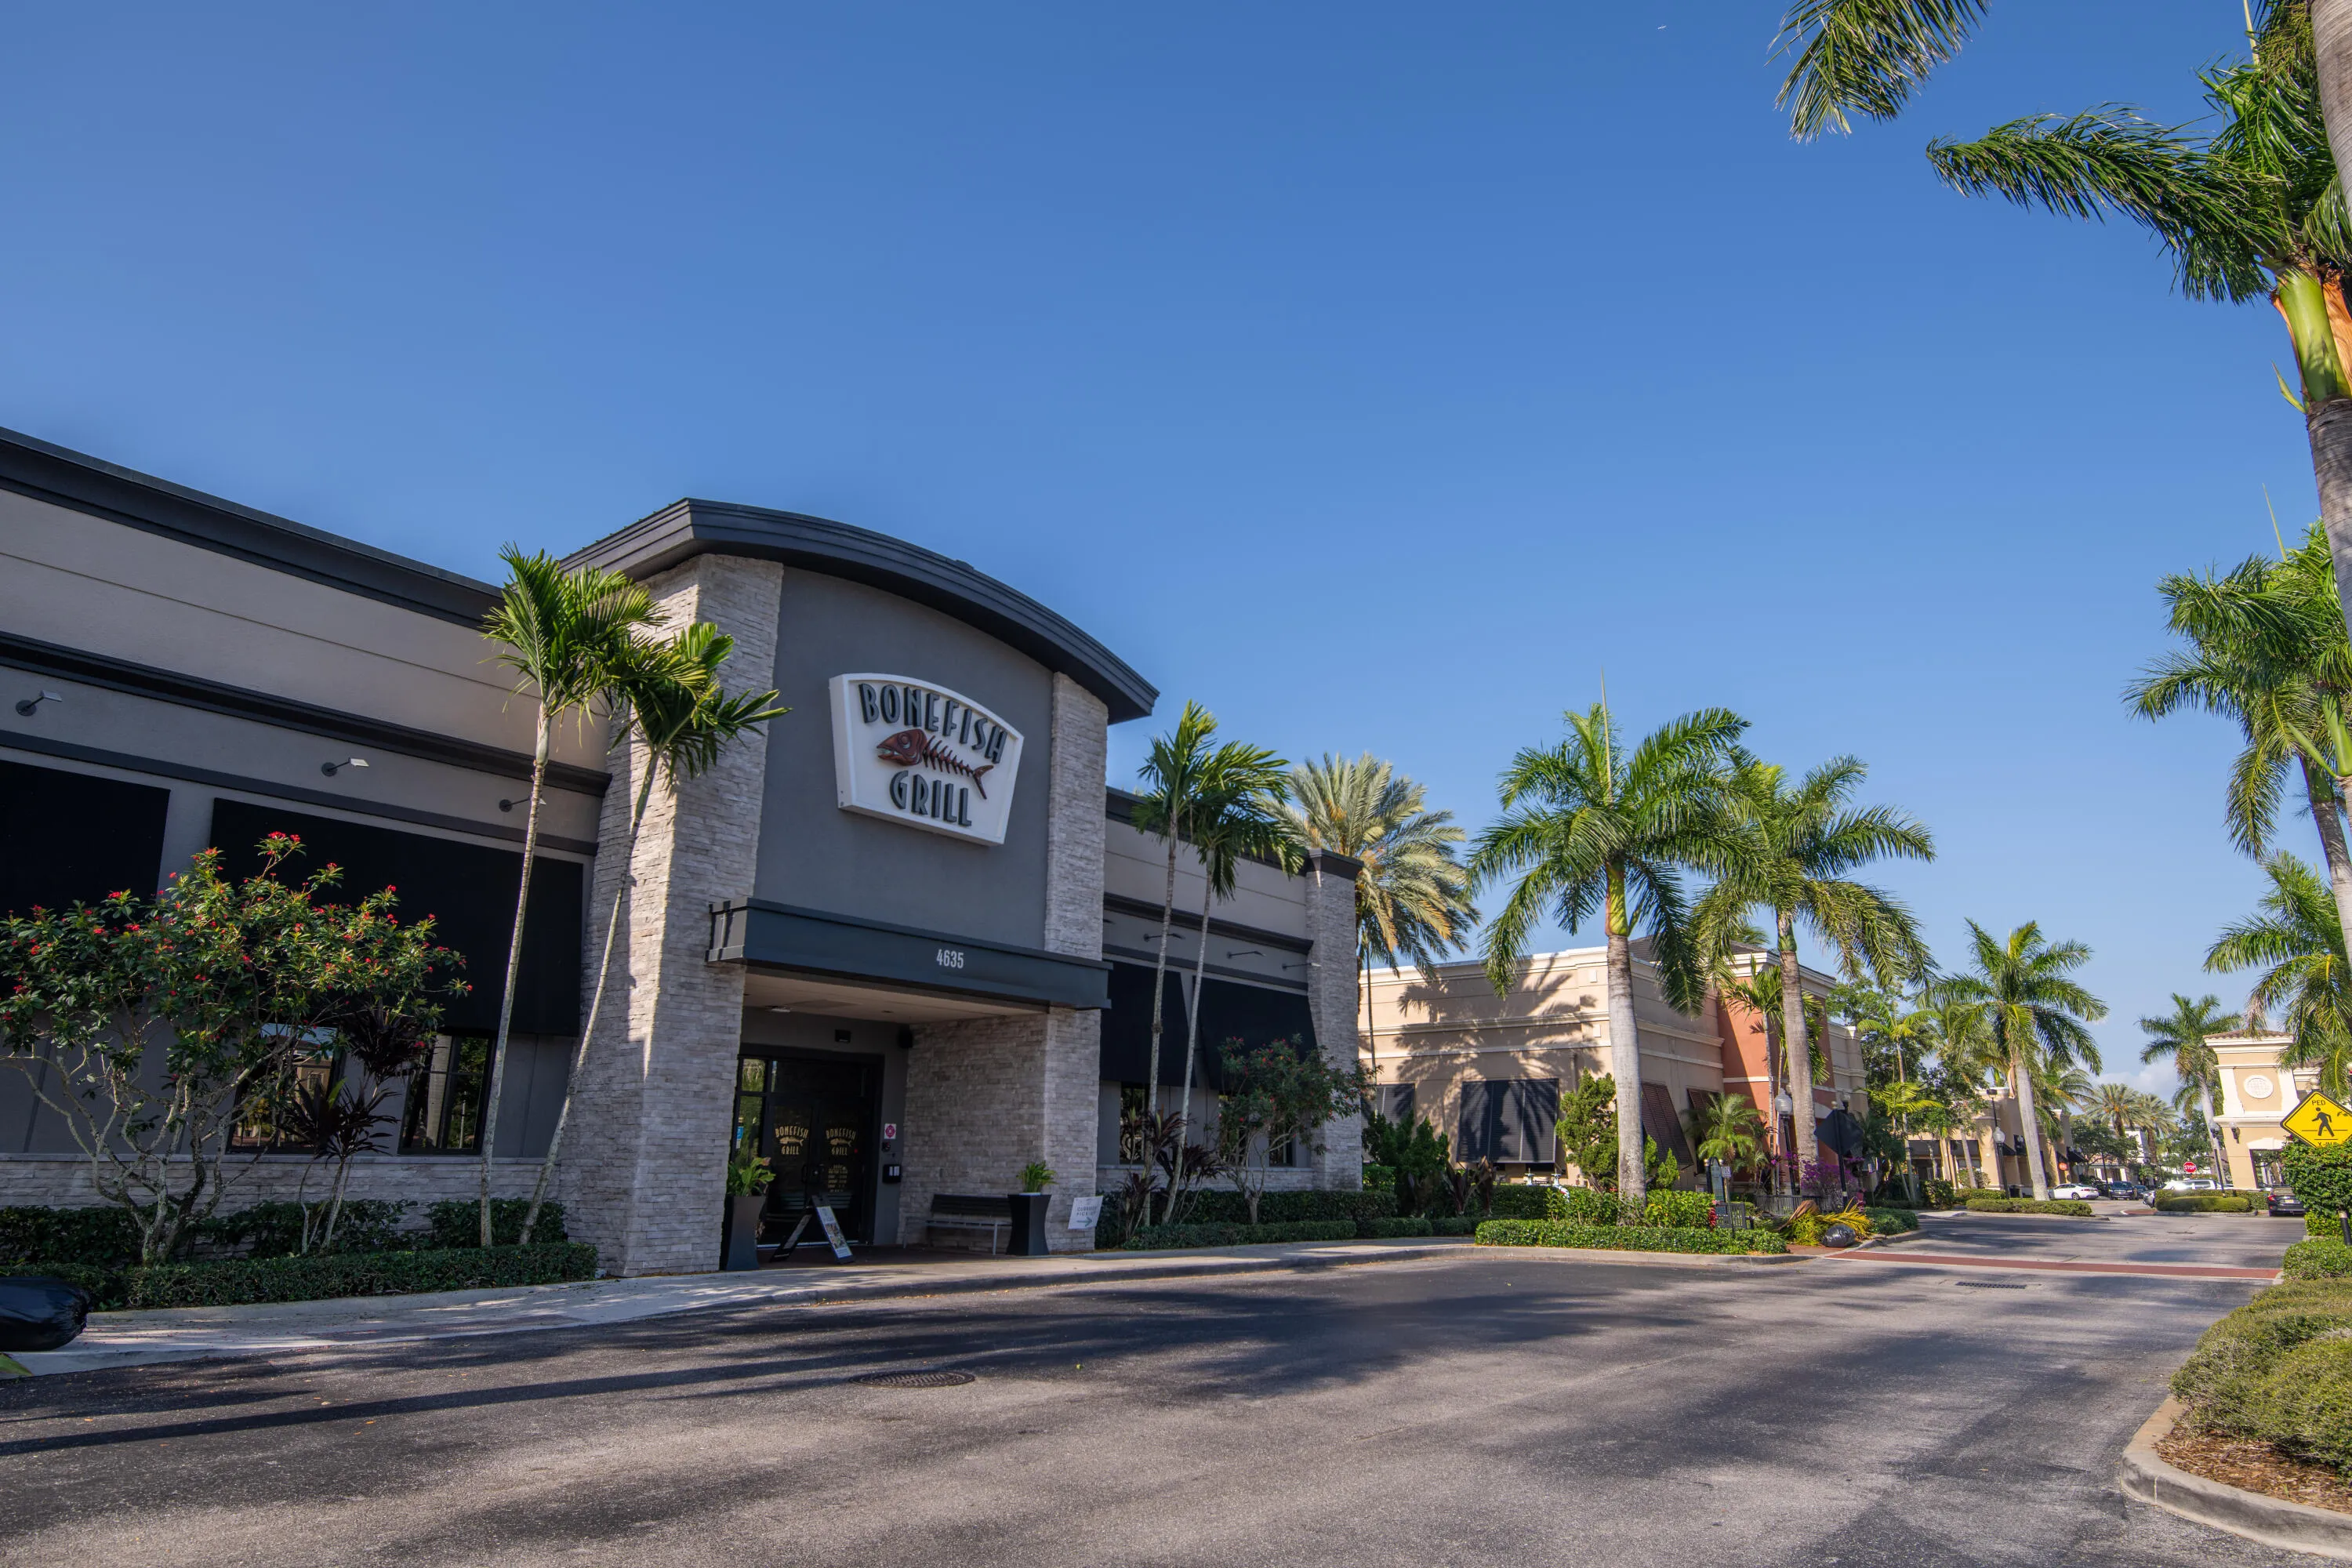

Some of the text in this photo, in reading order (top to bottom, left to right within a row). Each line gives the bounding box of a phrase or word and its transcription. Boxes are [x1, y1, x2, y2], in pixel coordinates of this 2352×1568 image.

[858, 683, 1007, 764] BONEFISH
[889, 770, 972, 826] GRILL
[936, 949, 964, 969] 4635
[775, 1126, 809, 1138] BONEFISH
[826, 1128, 856, 1141] BONEFISH
[781, 1145, 800, 1155] GRILL
[831, 1147, 848, 1156] GRILL
